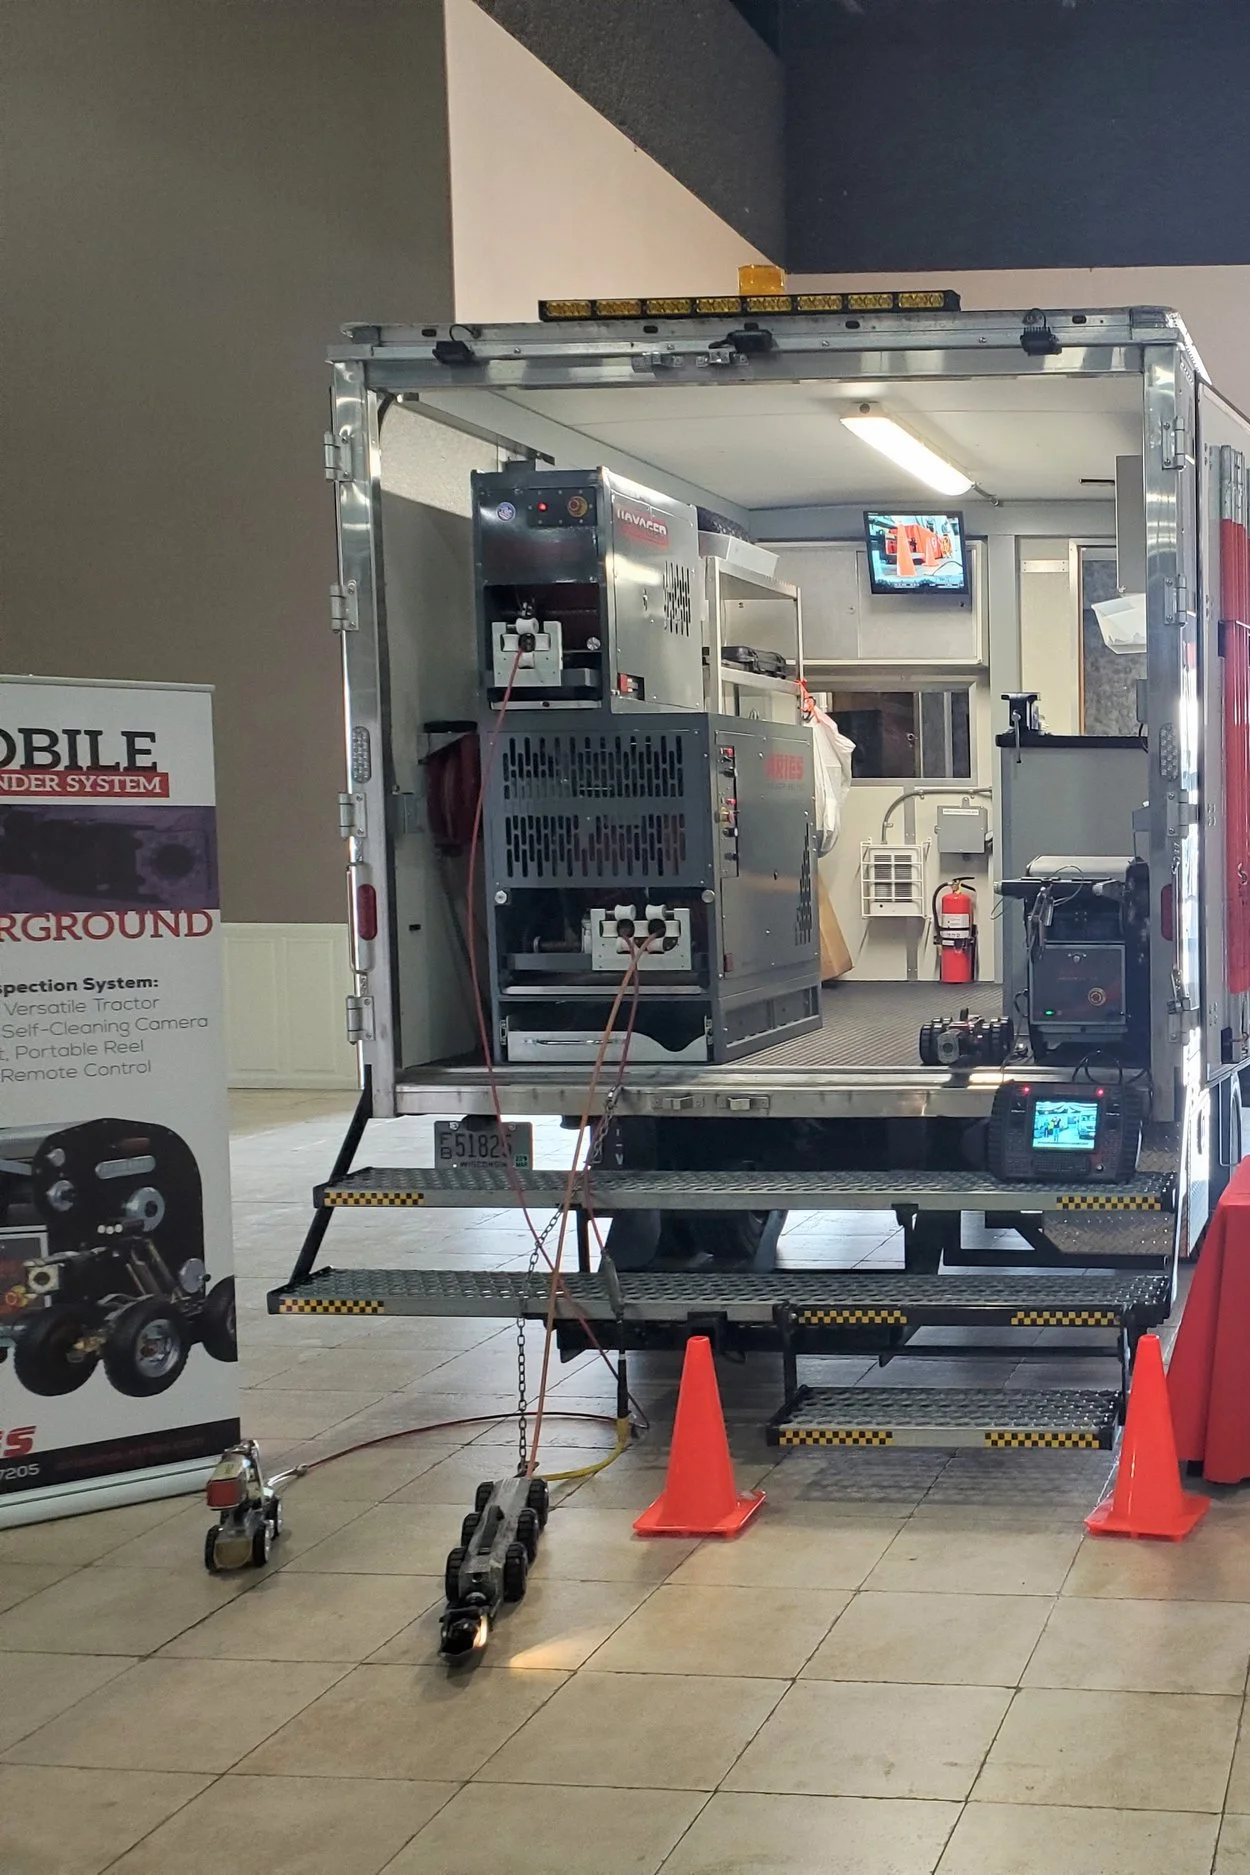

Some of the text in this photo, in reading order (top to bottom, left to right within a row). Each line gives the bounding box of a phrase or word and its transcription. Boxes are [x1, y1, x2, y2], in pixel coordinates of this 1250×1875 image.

[66, 775, 162, 793] SYSTEM
[0, 977, 159, 997] pection System:
[4, 998, 160, 1016] Versatile Tractor
[2, 1016, 208, 1039] Self-Cleaning Camera
[16, 1043, 98, 1060] Portable
[104, 1039, 144, 1054] Reel
[1, 1060, 151, 1082] Remote Control
